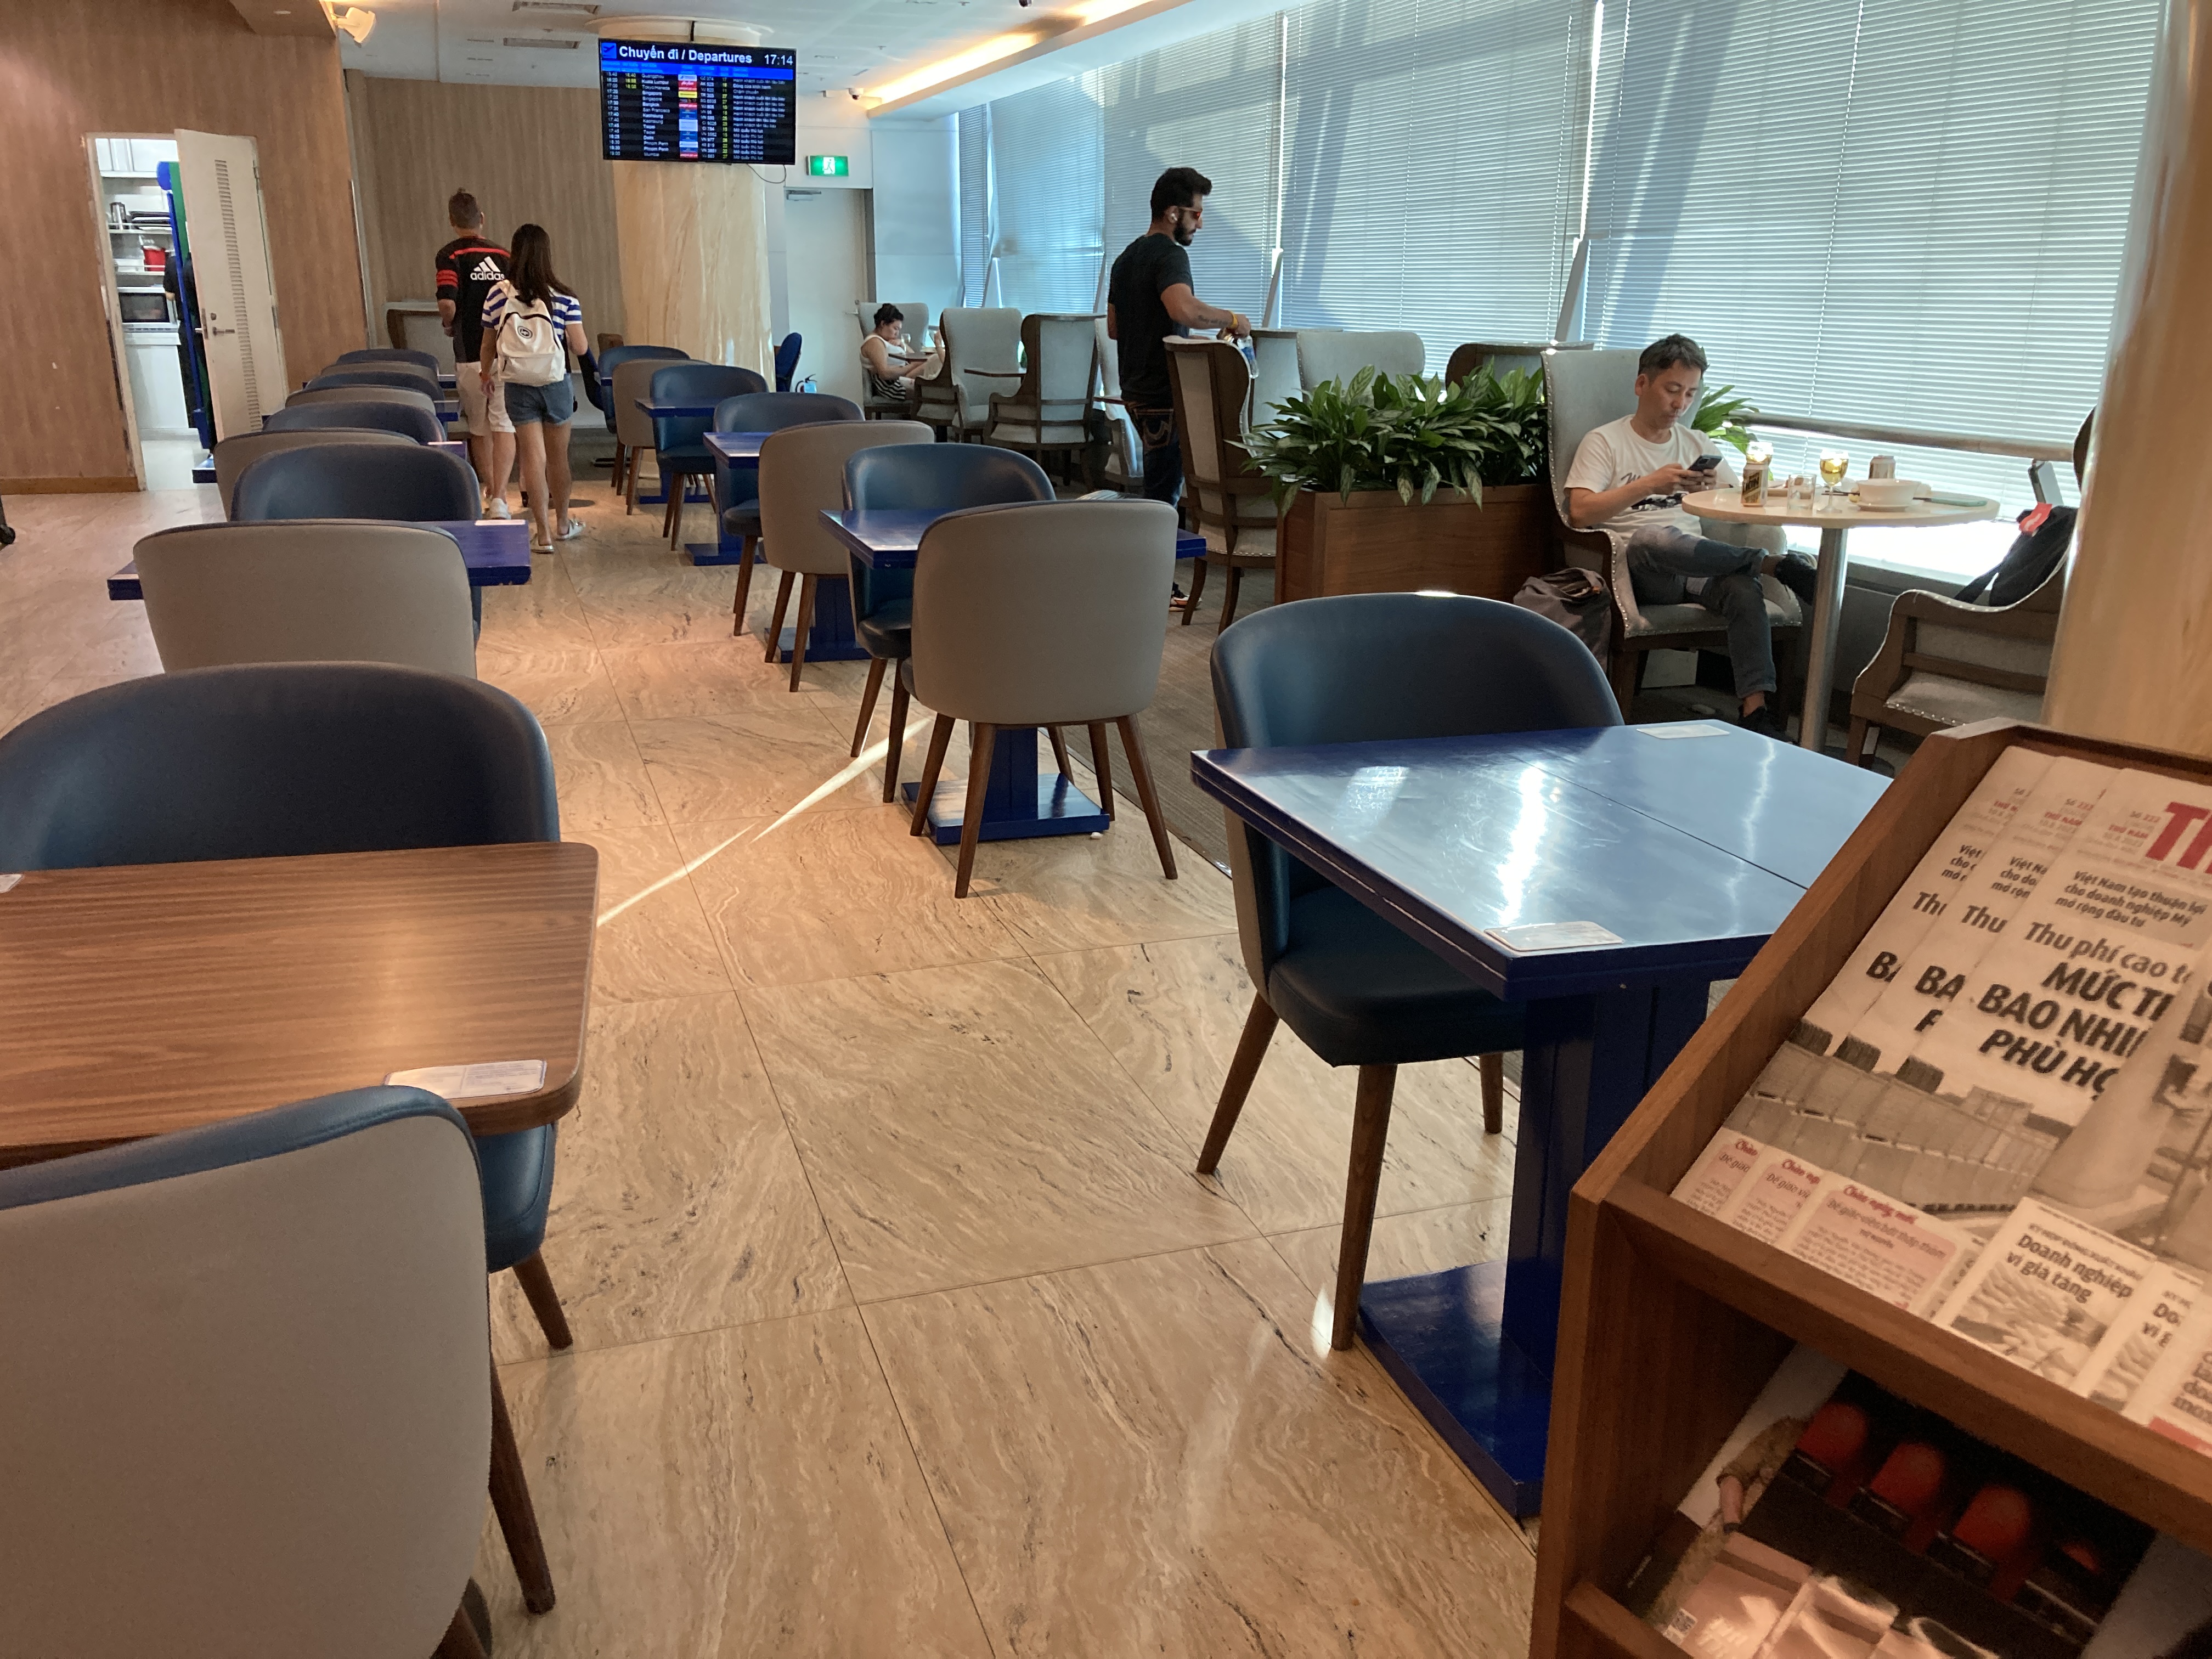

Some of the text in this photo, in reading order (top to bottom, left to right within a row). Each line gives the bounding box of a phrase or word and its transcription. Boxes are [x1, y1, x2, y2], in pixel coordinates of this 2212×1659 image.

[619, 45, 664, 60] Chuyến
[668, 48, 679, 59] đi
[689, 49, 752, 63] Departures
[764, 54, 793, 65] 17:14
[470, 271, 505, 281] adidas
[1961, 905, 2008, 933] Thu
[2024, 921, 2075, 951] Thu
[2068, 938, 2126, 963] phí
[2120, 952, 2169, 978] cao
[2041, 961, 2137, 1010] MỨC
[1977, 983, 2060, 1030] BAO
[1978, 1028, 2068, 1074] PHÙ
[2016, 1233, 2073, 1269] Doanh
